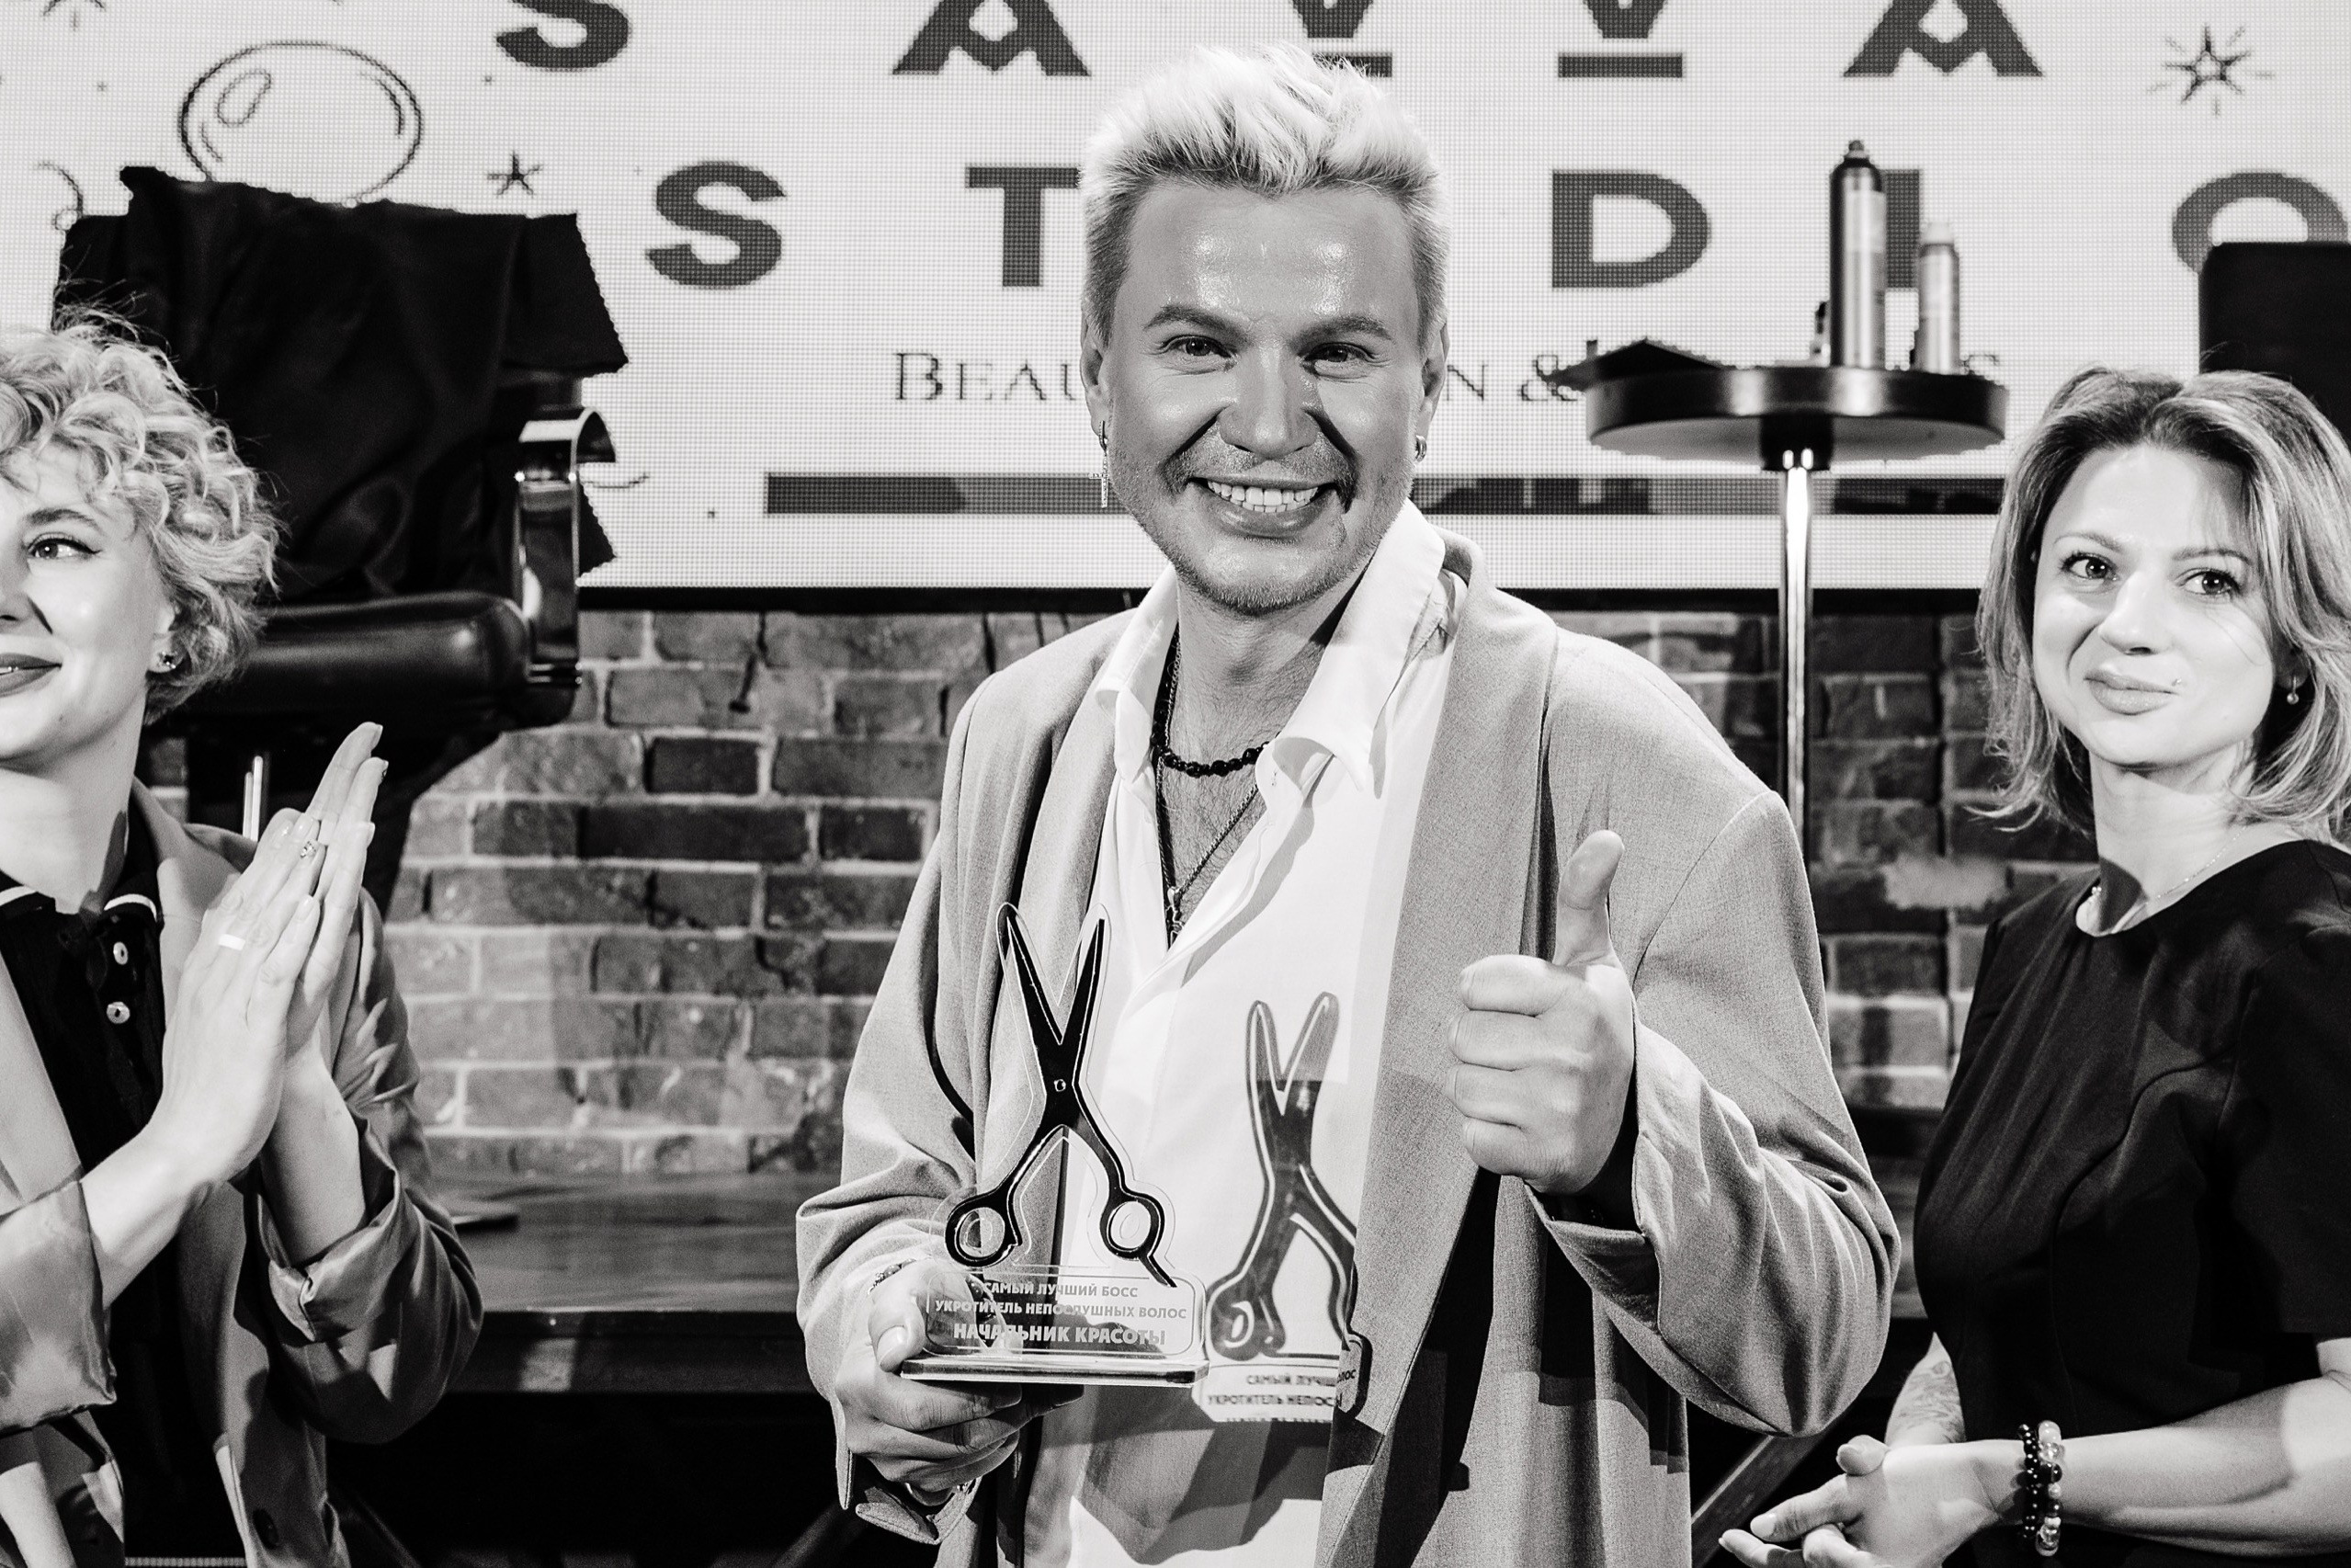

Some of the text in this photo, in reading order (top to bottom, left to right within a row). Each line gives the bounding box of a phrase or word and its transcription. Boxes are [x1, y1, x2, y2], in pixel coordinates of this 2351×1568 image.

[645, 160, 2349, 290] STDIO
[1037, 1283, 1097, 1297] ЛУЧШИЙ
[1101, 1286, 1139, 1298] БОСС
[1138, 1307, 1187, 1319] ВОЛОС
[1074, 1326, 1166, 1346] КРАСОТЫ
